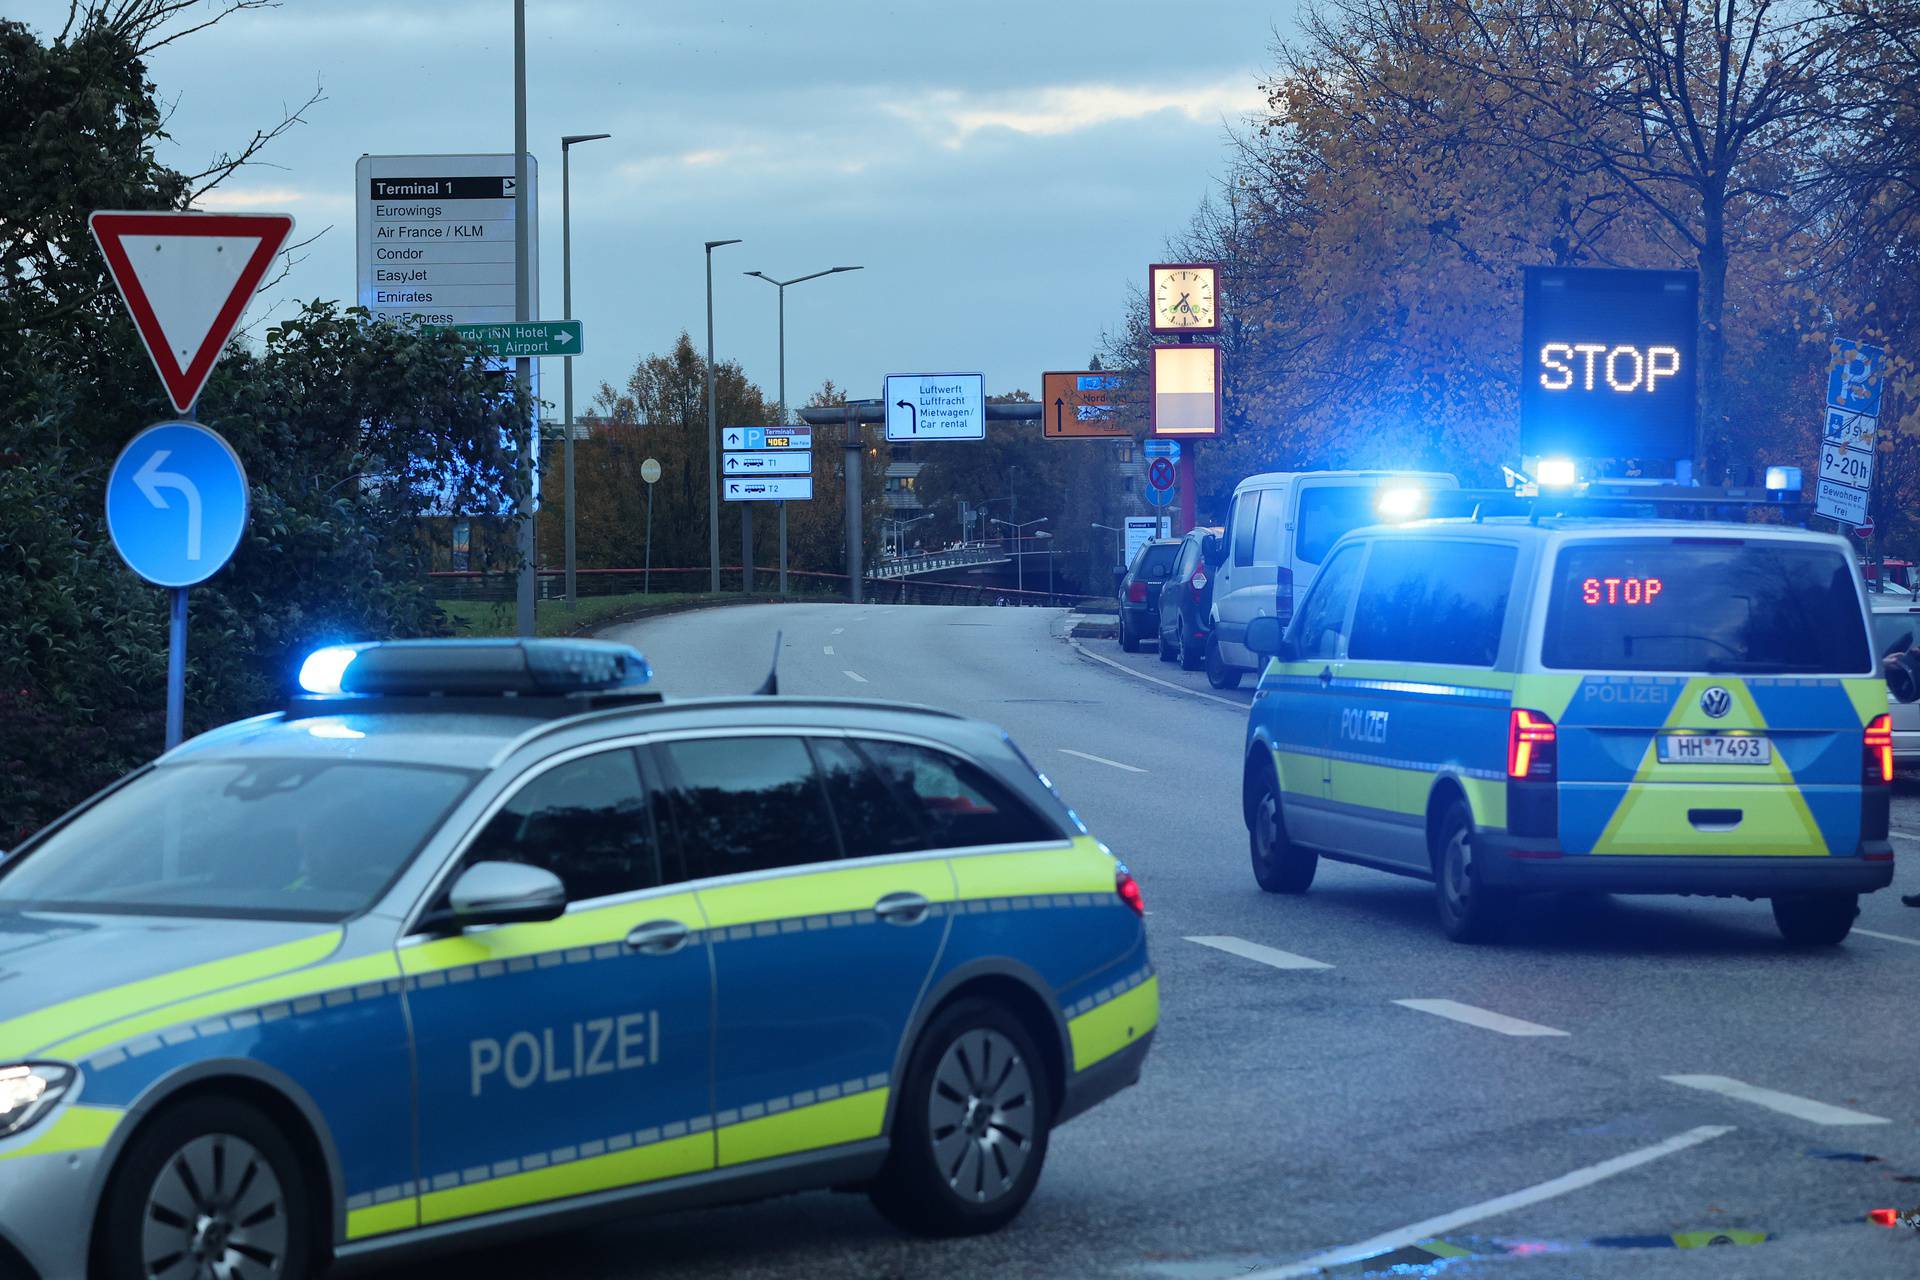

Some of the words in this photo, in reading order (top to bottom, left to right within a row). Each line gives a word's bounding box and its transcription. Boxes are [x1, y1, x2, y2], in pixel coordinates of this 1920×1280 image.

[376, 182, 439, 195] Terminal
[445, 182, 453, 194] 1
[376, 205, 442, 218] Eurowings
[377, 227, 394, 238] Air
[399, 226, 442, 238] France
[446, 225, 451, 237] /
[454, 225, 484, 237] KLM
[377, 248, 424, 260] Condor
[377, 269, 427, 283] EasyJet
[377, 291, 433, 303] Emirates
[516, 326, 548, 338] Hotel
[505, 341, 549, 355] Airport
[1541, 342, 1680, 393] STOP
[919, 385, 962, 395] Luftwerft
[919, 396, 965, 406] Luftfracht
[920, 408, 975, 419] Mietwagen/
[920, 419, 938, 429] Car
[941, 419, 968, 429] rental
[768, 459, 777, 467] T1
[1825, 453, 1867, 479] 9-20h
[1822, 485, 1862, 504] Bewohner
[1834, 504, 1848, 517] frei
[1583, 578, 1662, 604] STOP
[1584, 684, 1668, 703] POLIZEI
[1340, 707, 1390, 744] POLIZEI
[1678, 739, 1703, 756] HH
[1714, 738, 1760, 757] 7493
[470, 1010, 660, 1097] POLIZEI
